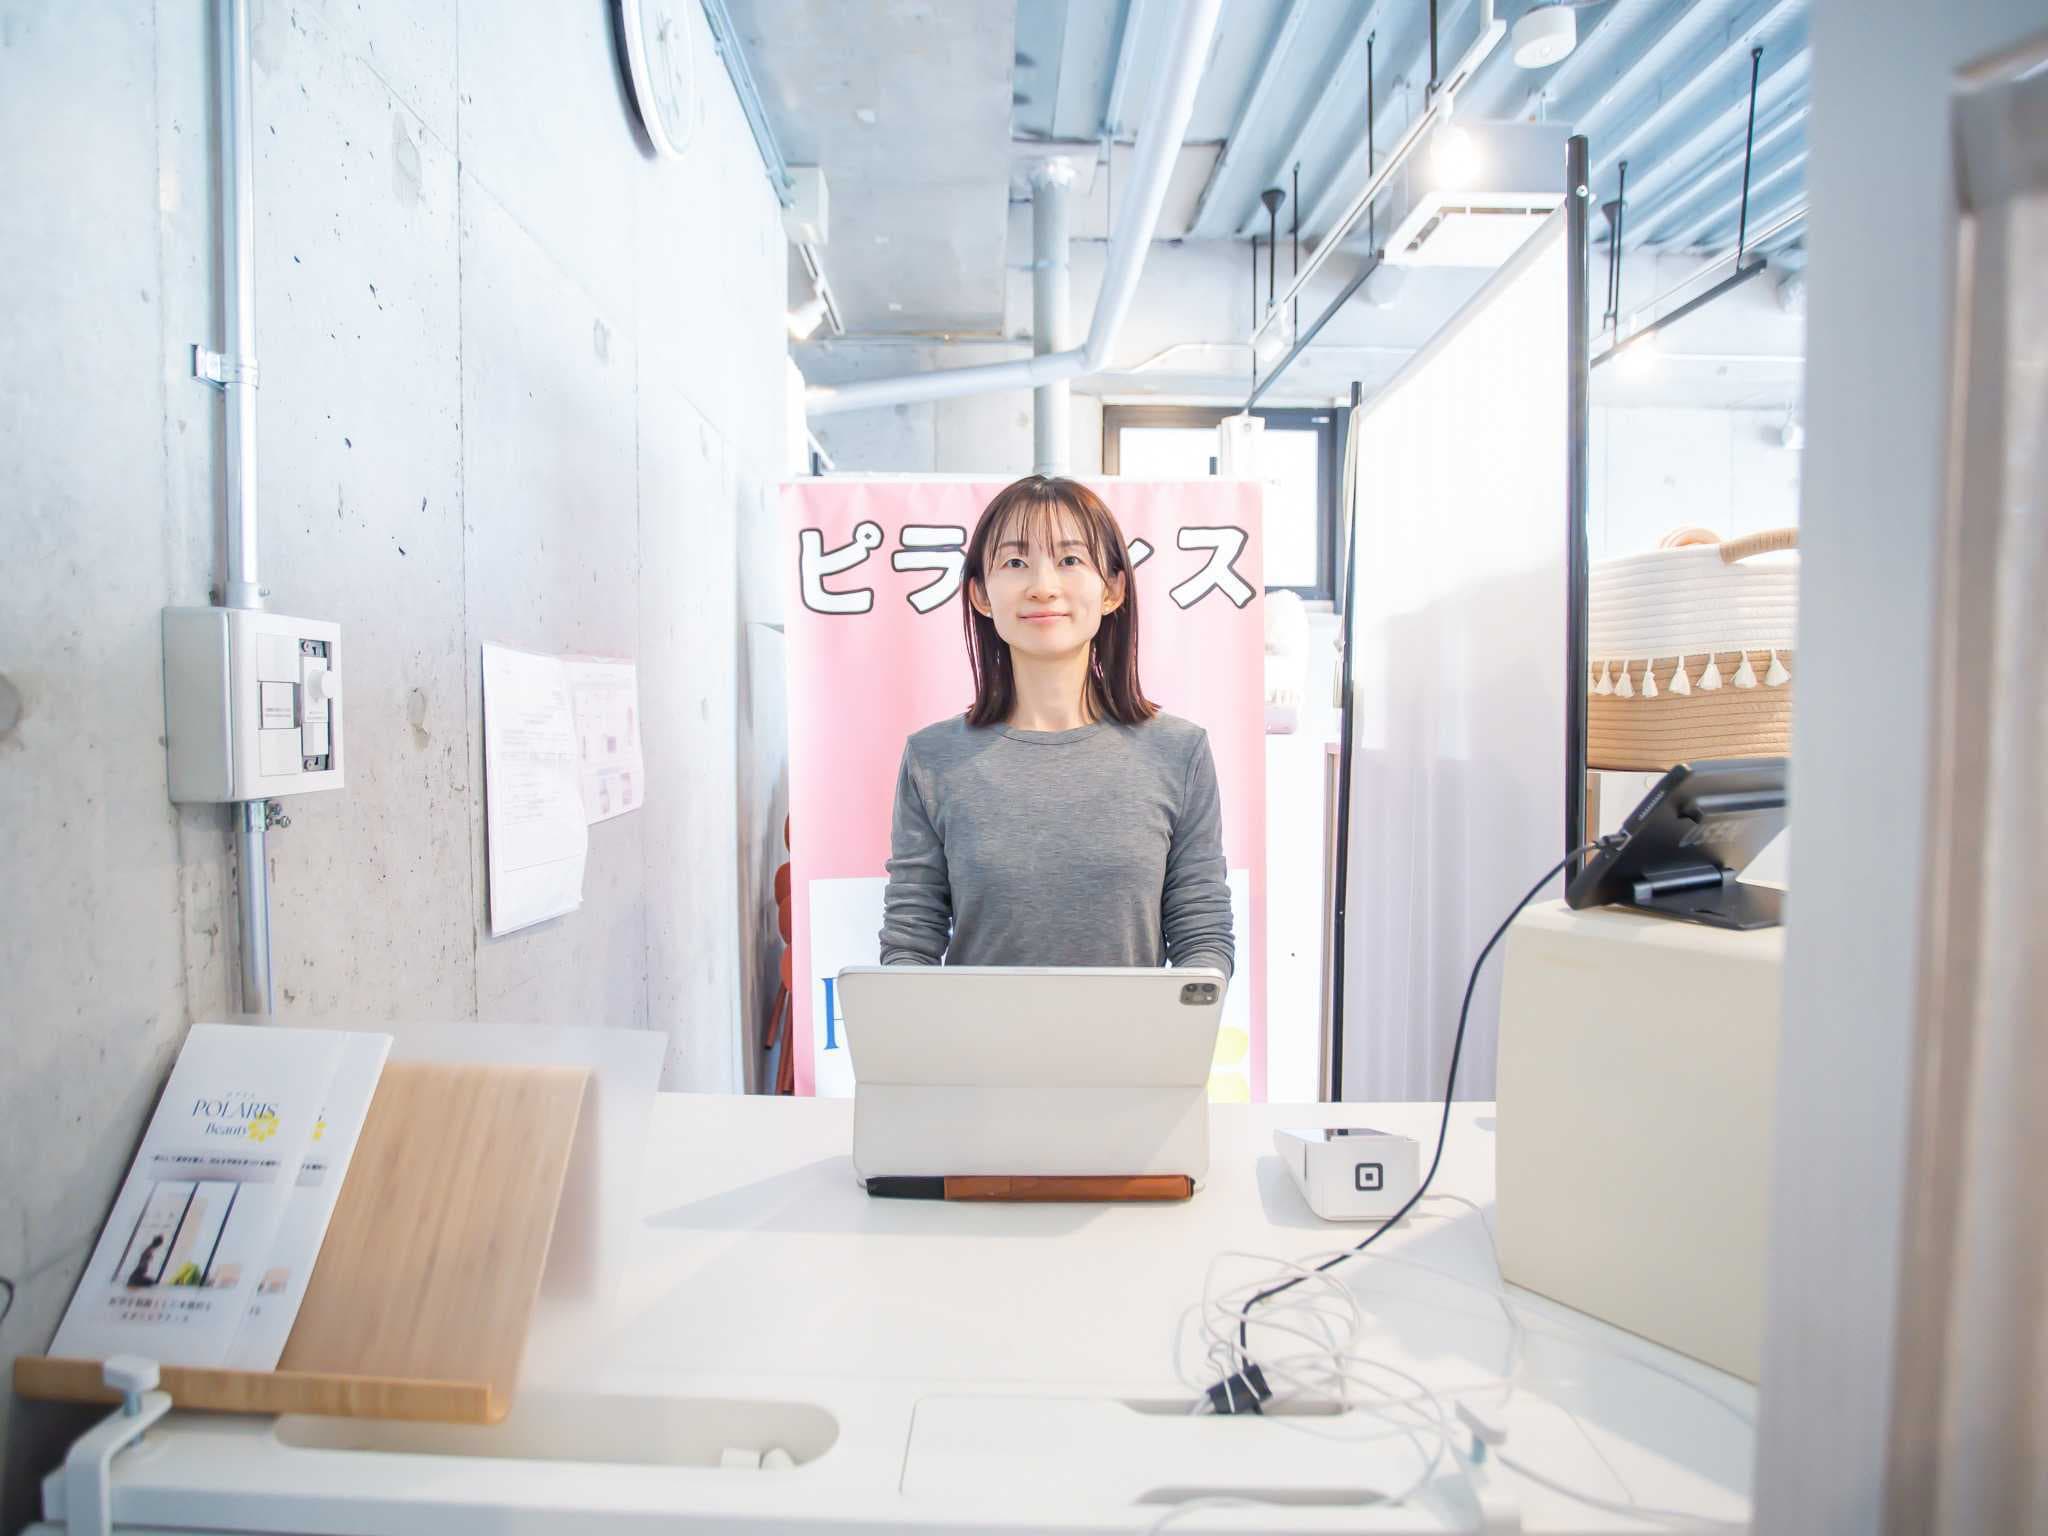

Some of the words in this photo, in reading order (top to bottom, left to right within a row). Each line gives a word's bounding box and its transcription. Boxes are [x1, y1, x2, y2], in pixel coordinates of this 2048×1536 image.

[799, 521, 1257, 615] ピラス
[192, 1098, 279, 1120] POLARIS
[204, 1122, 249, 1137] Beauty
